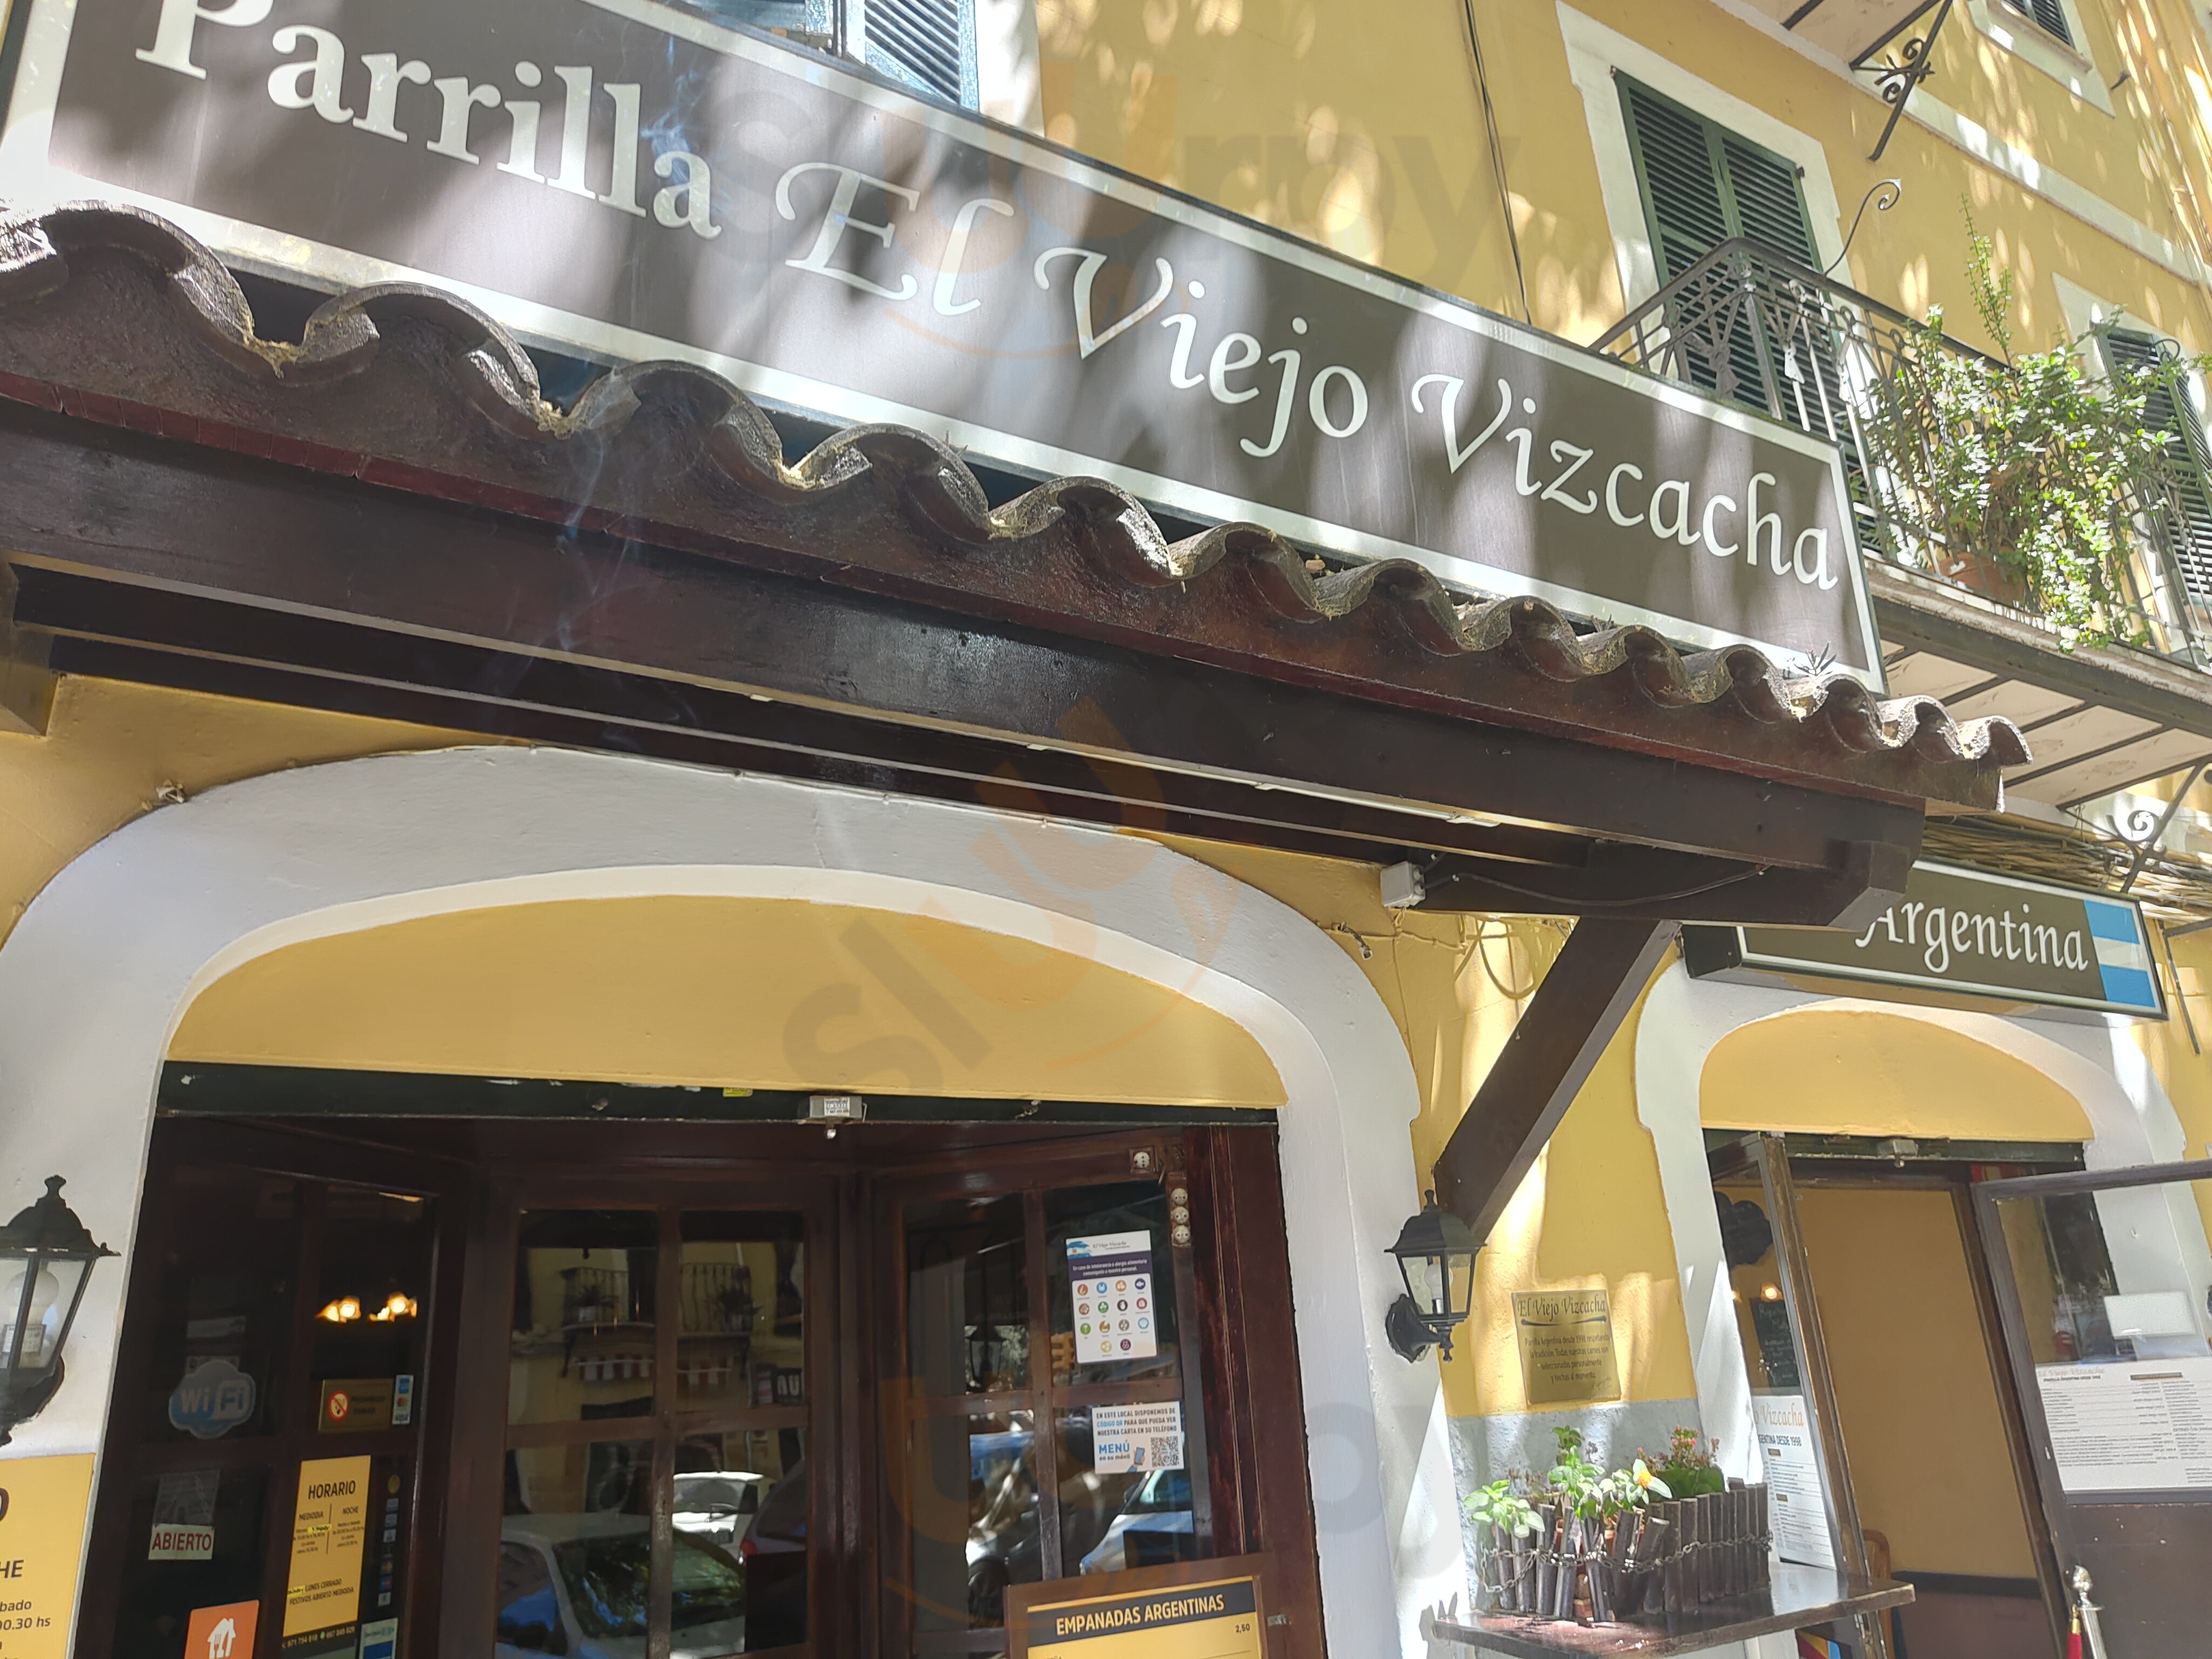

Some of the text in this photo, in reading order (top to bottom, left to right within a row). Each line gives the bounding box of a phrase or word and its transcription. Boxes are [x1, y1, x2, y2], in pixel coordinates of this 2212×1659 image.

[136, 0, 1837, 590] Parrilla El Viejo Vizcacha
[1855, 901, 2088, 973] Argentina
[1518, 1294, 1606, 1321] El Viejo Vizcacha
[1099, 1439, 1130, 1454] MENÚ
[308, 1480, 356, 1499] HORARIO
[152, 1532, 212, 1551] ABIERTO
[0, 1616, 51, 1630] 0.30 hs
[1056, 1594, 1225, 1636] EMPANADAS ARGENTINAS
[1235, 1623, 1251, 1634] 2,50
